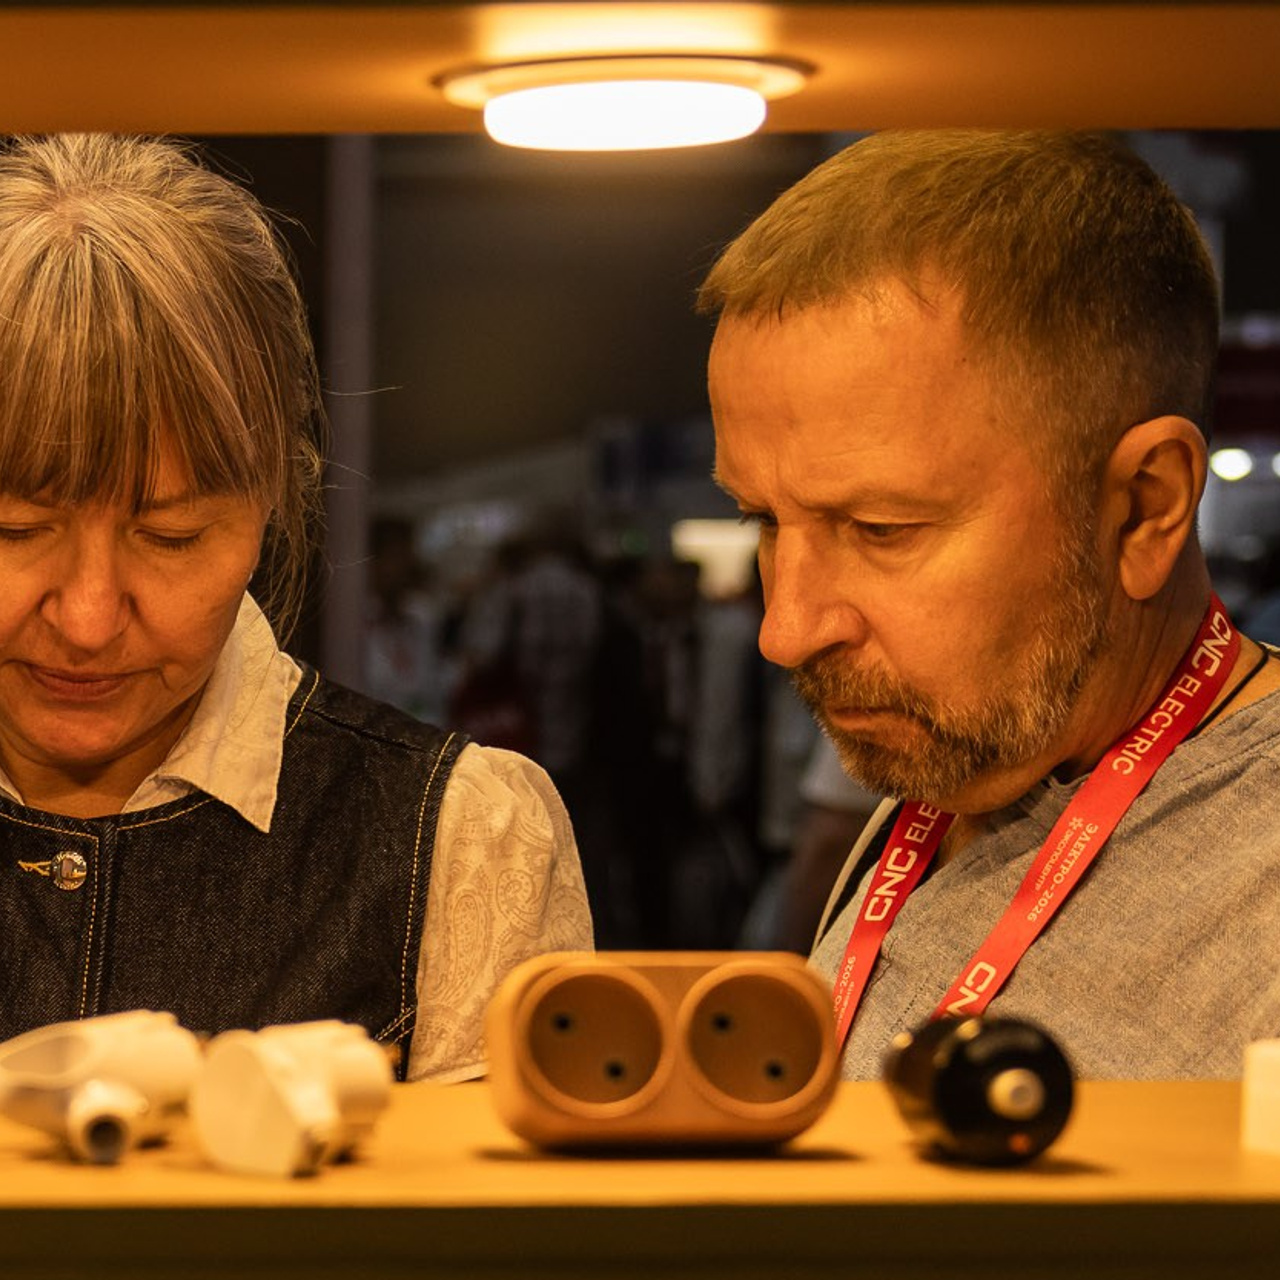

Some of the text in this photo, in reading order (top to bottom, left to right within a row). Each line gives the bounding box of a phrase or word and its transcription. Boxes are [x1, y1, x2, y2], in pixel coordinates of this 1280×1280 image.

[1112, 611, 1232, 775] CNC ELECTRIC
[864, 803, 941, 922] CNC ELE
[1027, 823, 1099, 922] ЭЛЕКТРО-2026
[946, 961, 997, 1016] CN
